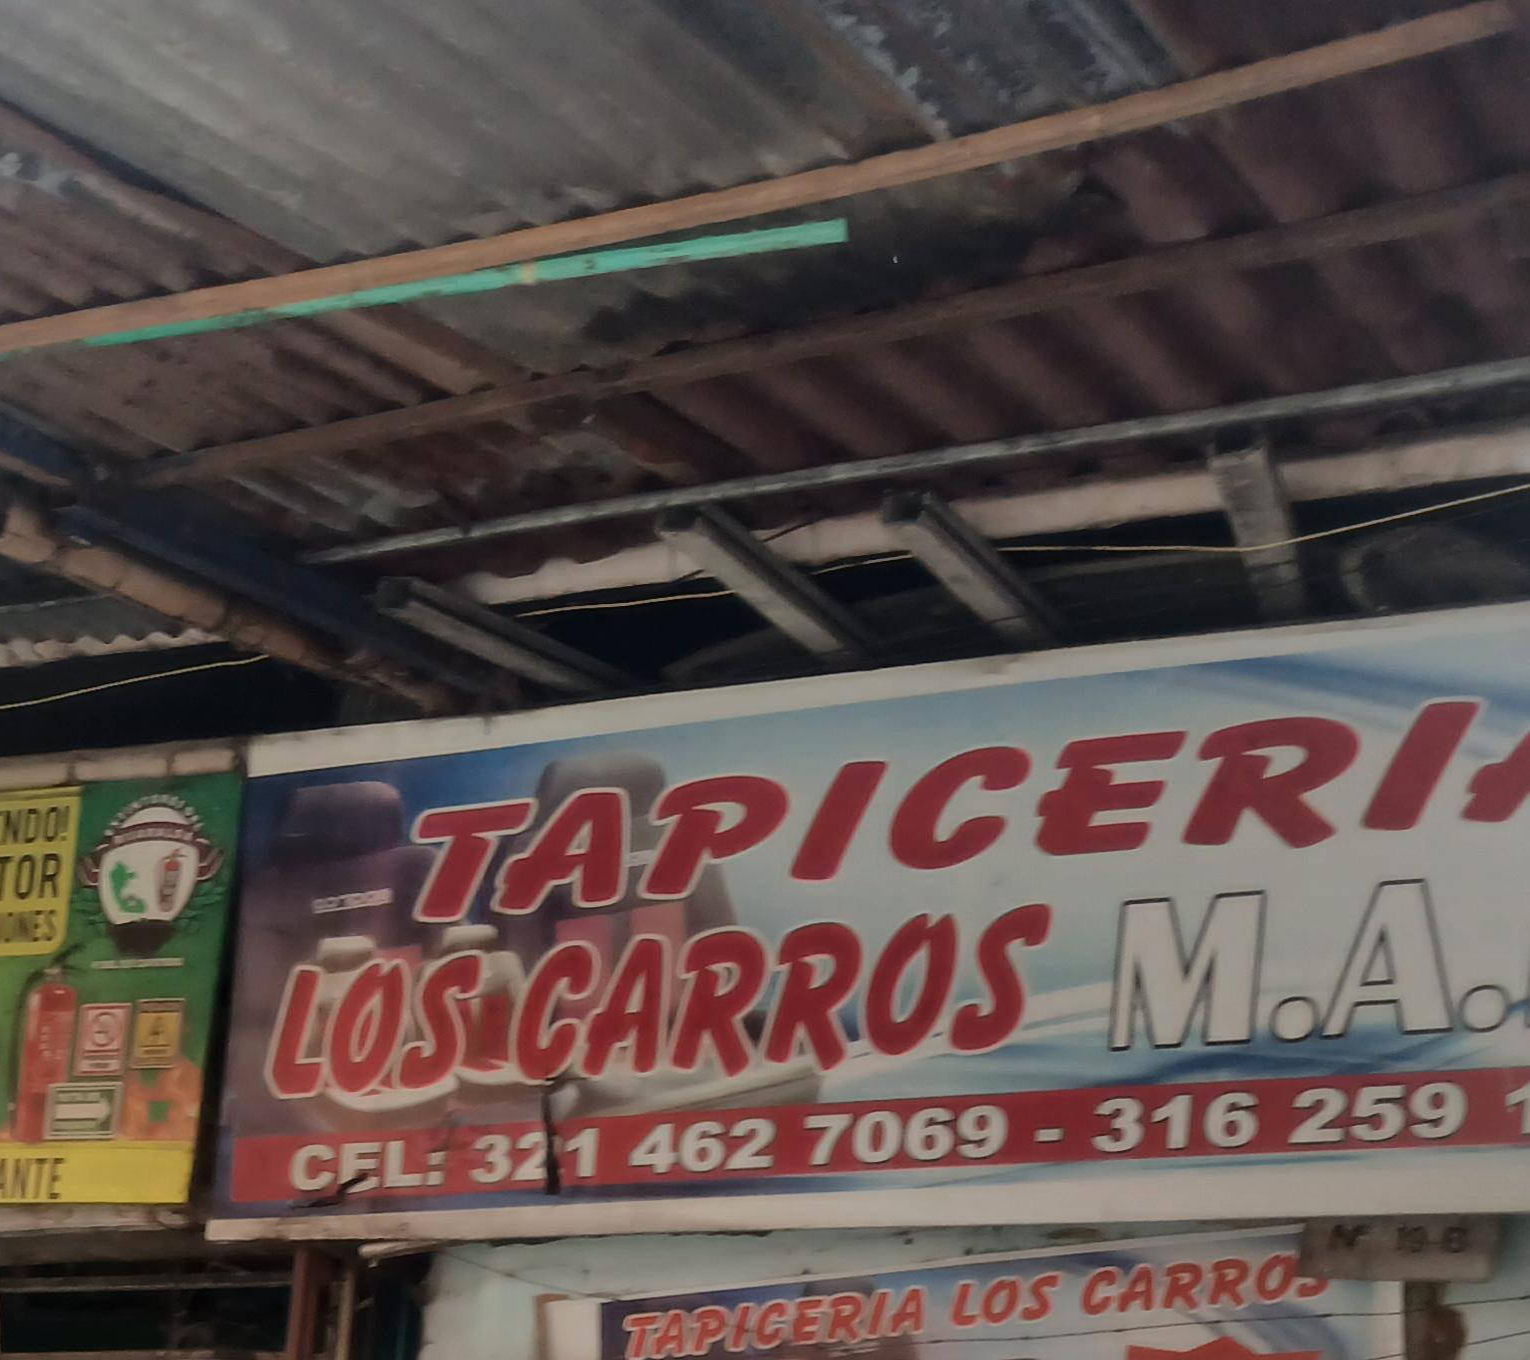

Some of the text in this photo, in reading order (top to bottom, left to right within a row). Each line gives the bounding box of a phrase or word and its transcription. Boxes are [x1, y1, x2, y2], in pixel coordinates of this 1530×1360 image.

[271, 878, 1530, 1097] LOS CARROS M.A.
[290, 1139, 447, 1194] CEL:
[471, 1127, 599, 1184] 321
[629, 1117, 777, 1173] 462
[803, 1103, 1008, 1167] 7069
[1092, 1092, 1260, 1154] 316
[1286, 1080, 1469, 1145] 259
[625, 1287, 924, 1360] TAPICERIA
[951, 1273, 1058, 1327] LOS
